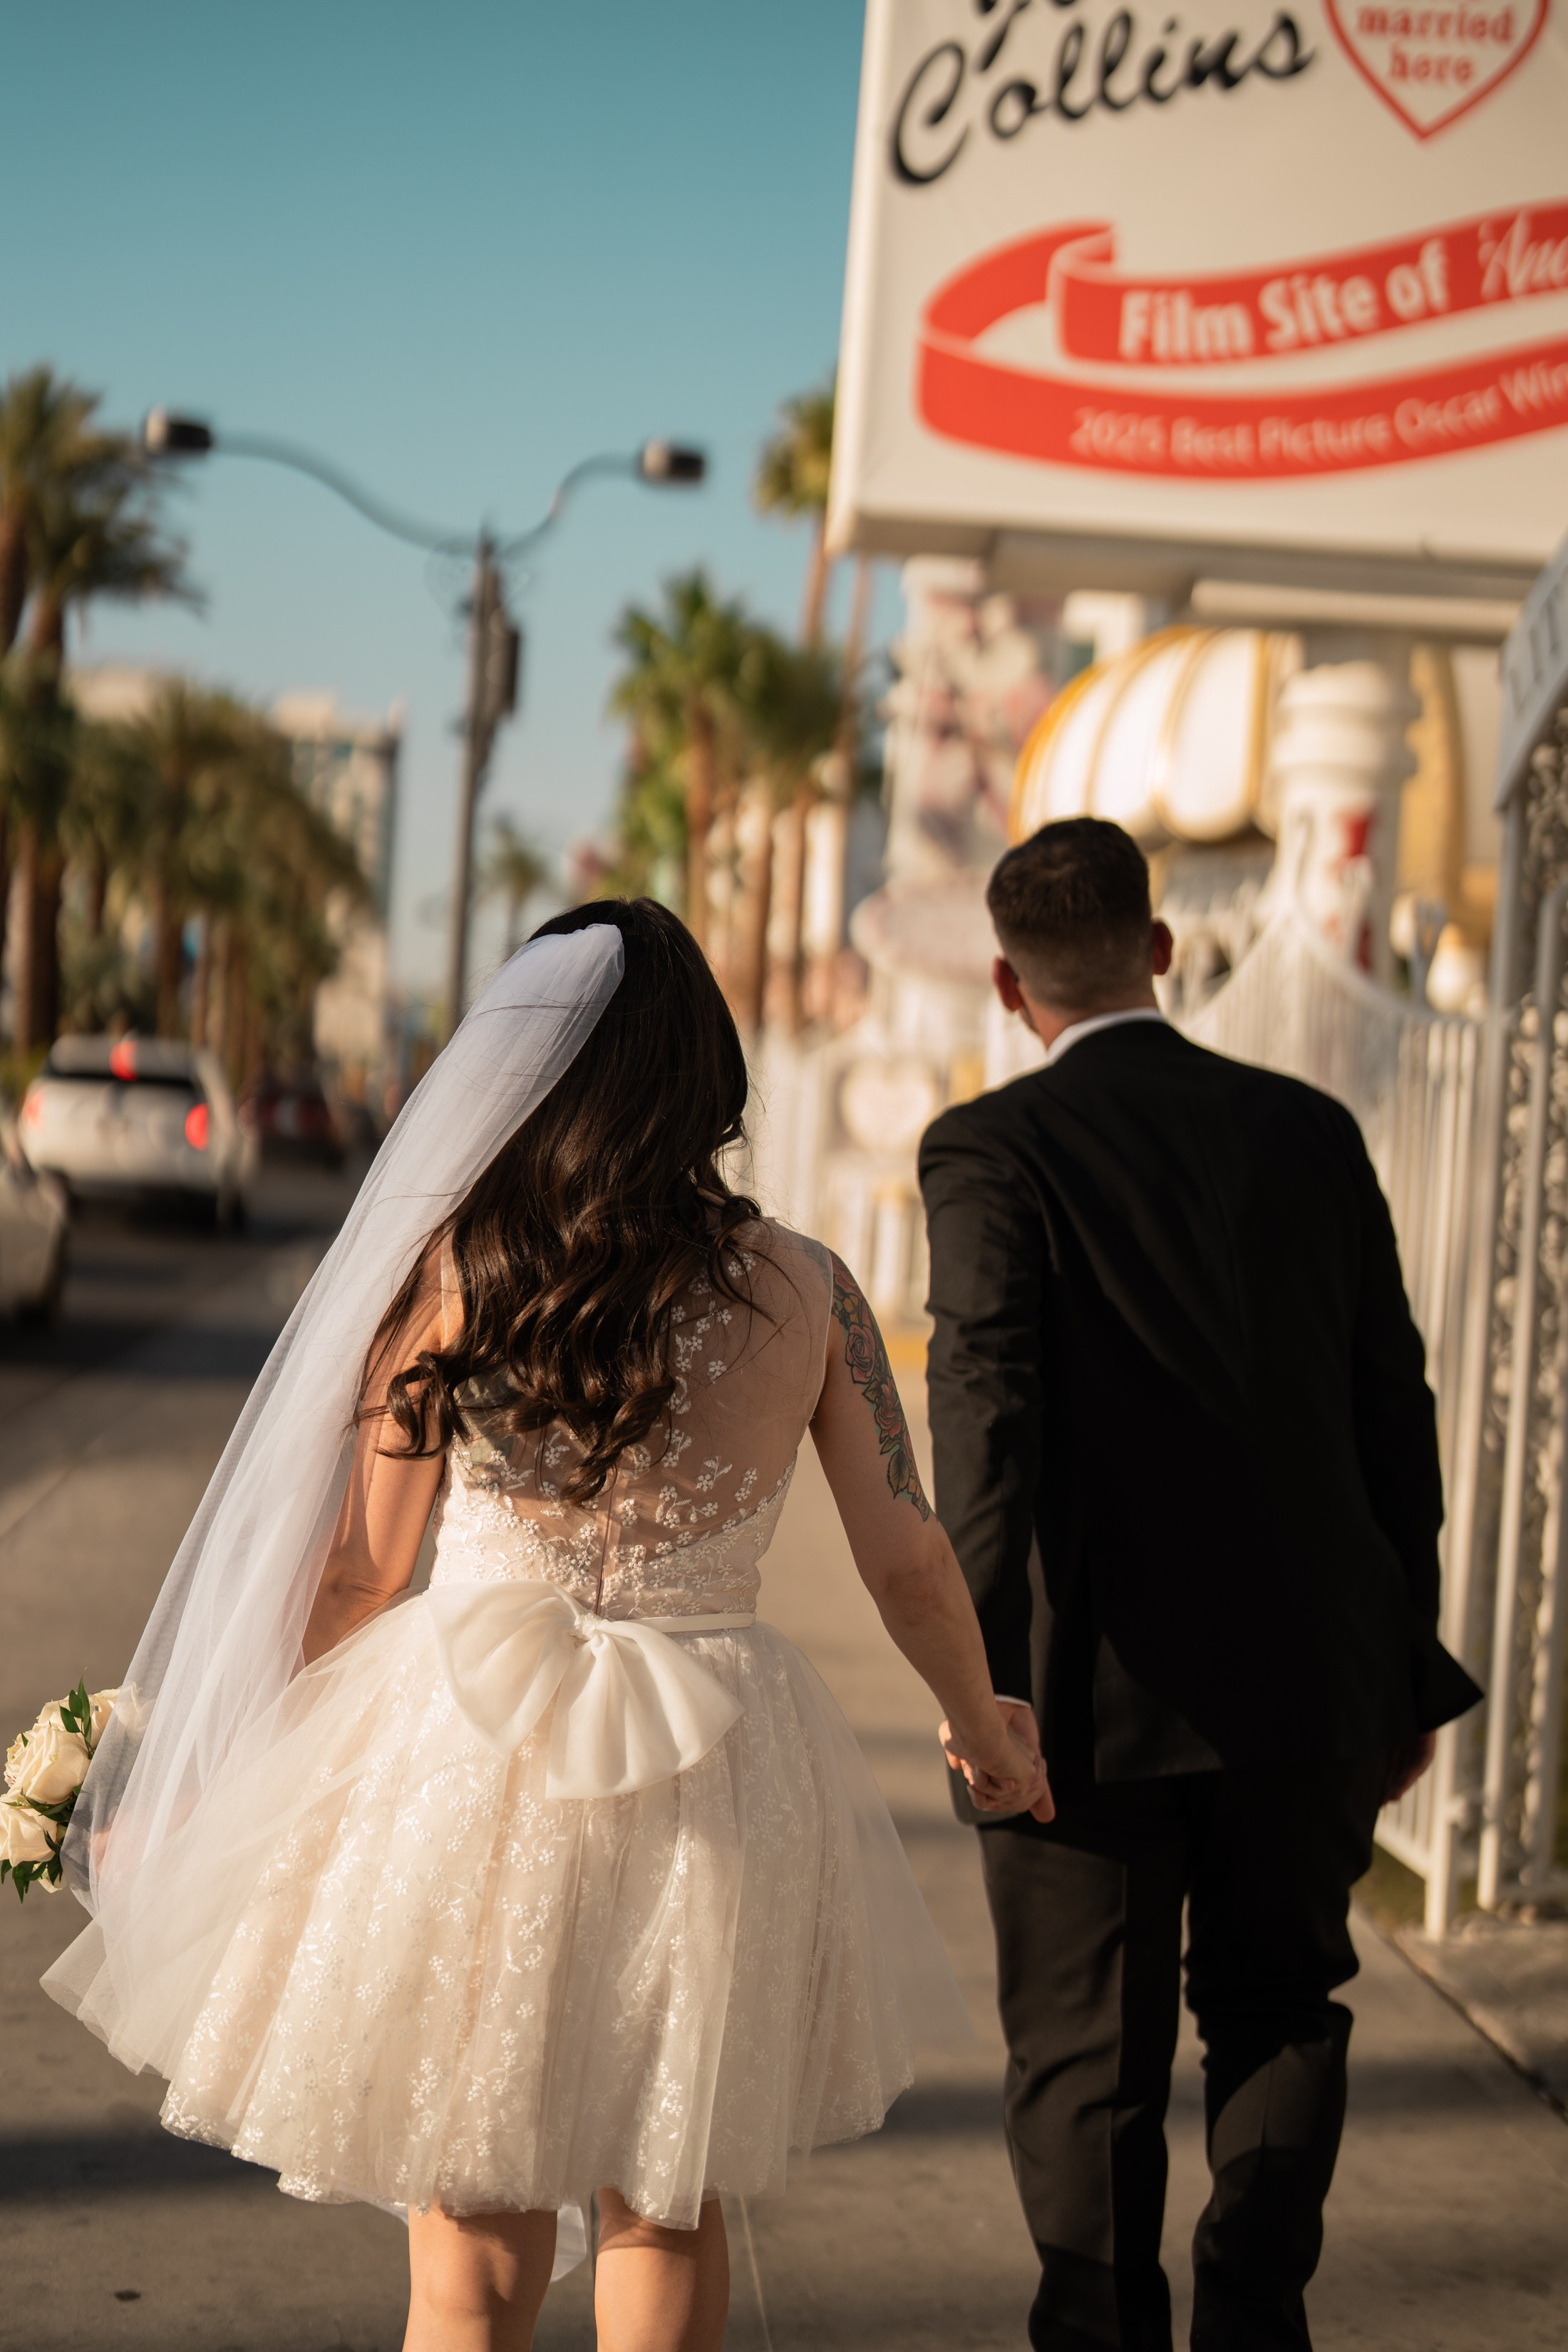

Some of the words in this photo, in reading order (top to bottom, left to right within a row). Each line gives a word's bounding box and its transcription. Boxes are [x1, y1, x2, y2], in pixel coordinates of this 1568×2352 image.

[1357, 4, 1514, 44] married
[1389, 41, 1475, 86] here
[889, 9, 1316, 187] Collins
[1120, 288, 1253, 361] Film
[1259, 274, 1377, 352] Site
[1386, 238, 1445, 321] of
[1170, 416, 1254, 466] Best
[1259, 413, 1391, 463] Picture
[1394, 383, 1501, 449] Oscar
[1509, 564, 1568, 720] LIT
